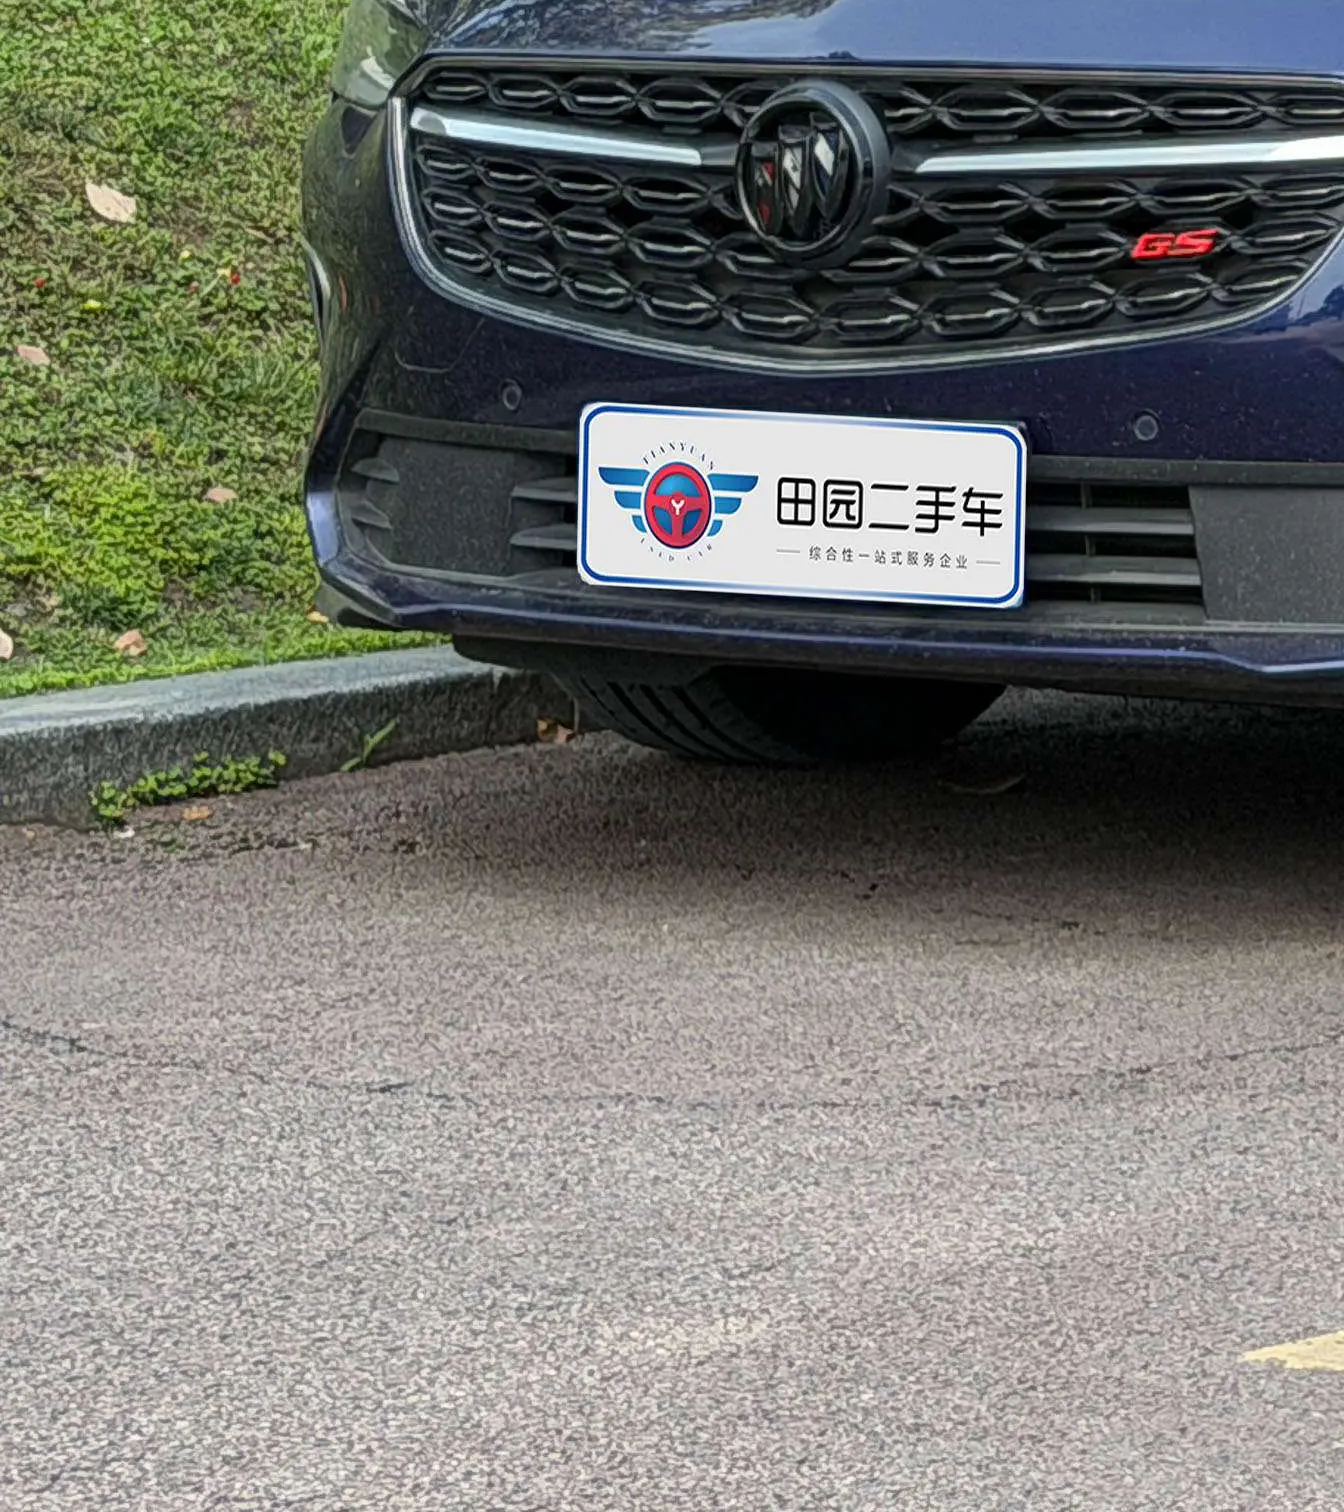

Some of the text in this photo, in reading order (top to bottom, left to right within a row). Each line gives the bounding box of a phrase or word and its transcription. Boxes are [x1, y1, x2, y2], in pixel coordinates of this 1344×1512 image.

[1130, 229, 1217, 259] GS
[777, 477, 1004, 536] 田园二手车
[809, 545, 968, 570] 综合性一站式服务企业
